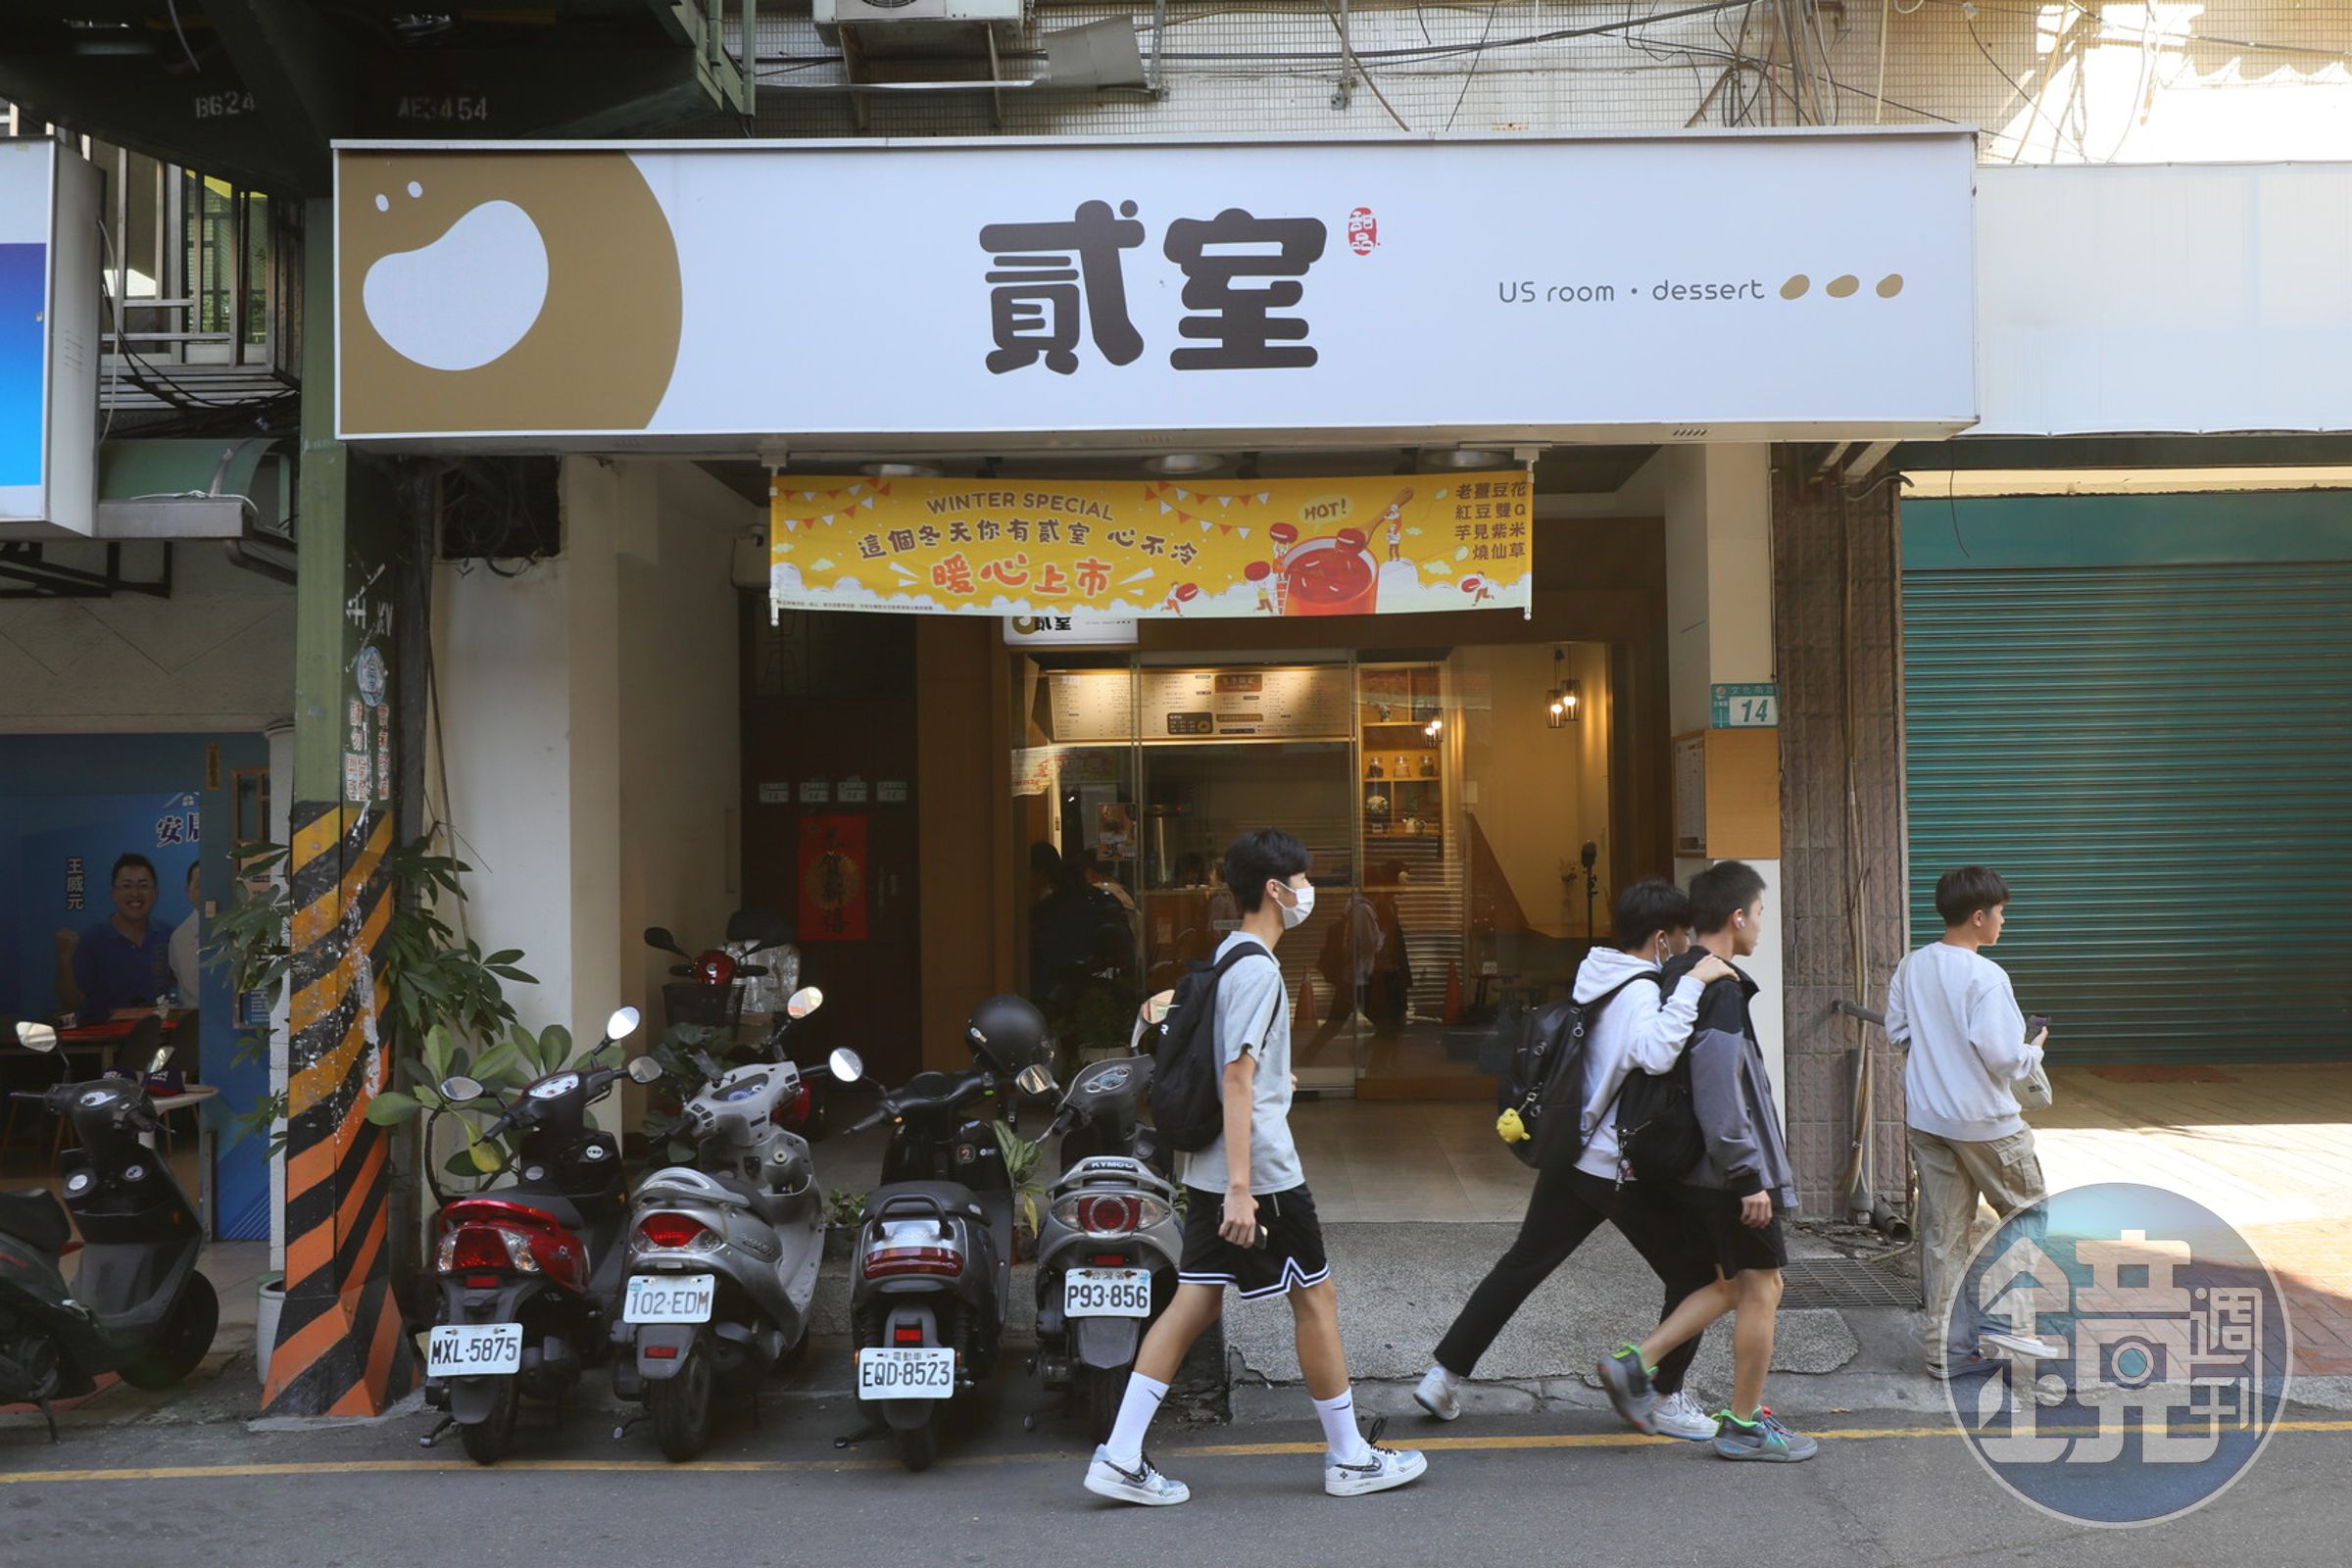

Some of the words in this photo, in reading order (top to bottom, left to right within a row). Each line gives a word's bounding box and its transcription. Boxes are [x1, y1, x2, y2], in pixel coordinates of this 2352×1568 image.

[979, 200, 1328, 375] 貳室
[1498, 280, 1537, 304] US
[1547, 284, 1615, 303] room
[1652, 278, 1765, 302] dessert
[1455, 481, 1527, 501] 老薑豆花
[926, 491, 1015, 515] WINTER
[1023, 491, 1114, 521] SPECIAL
[1304, 498, 1348, 521] HOT!
[1455, 503, 1526, 520] 紅豆雙Q
[857, 518, 1091, 561] 這個冬天你有貳室
[1106, 529, 1199, 565] 心不冷
[1454, 522, 1526, 540] 芋見紫米
[1472, 543, 1526, 561] 燒仙草
[931, 553, 1112, 598] 暖心上市
[1740, 698, 1770, 723] 14
[67, 858, 84, 910] 王威元
